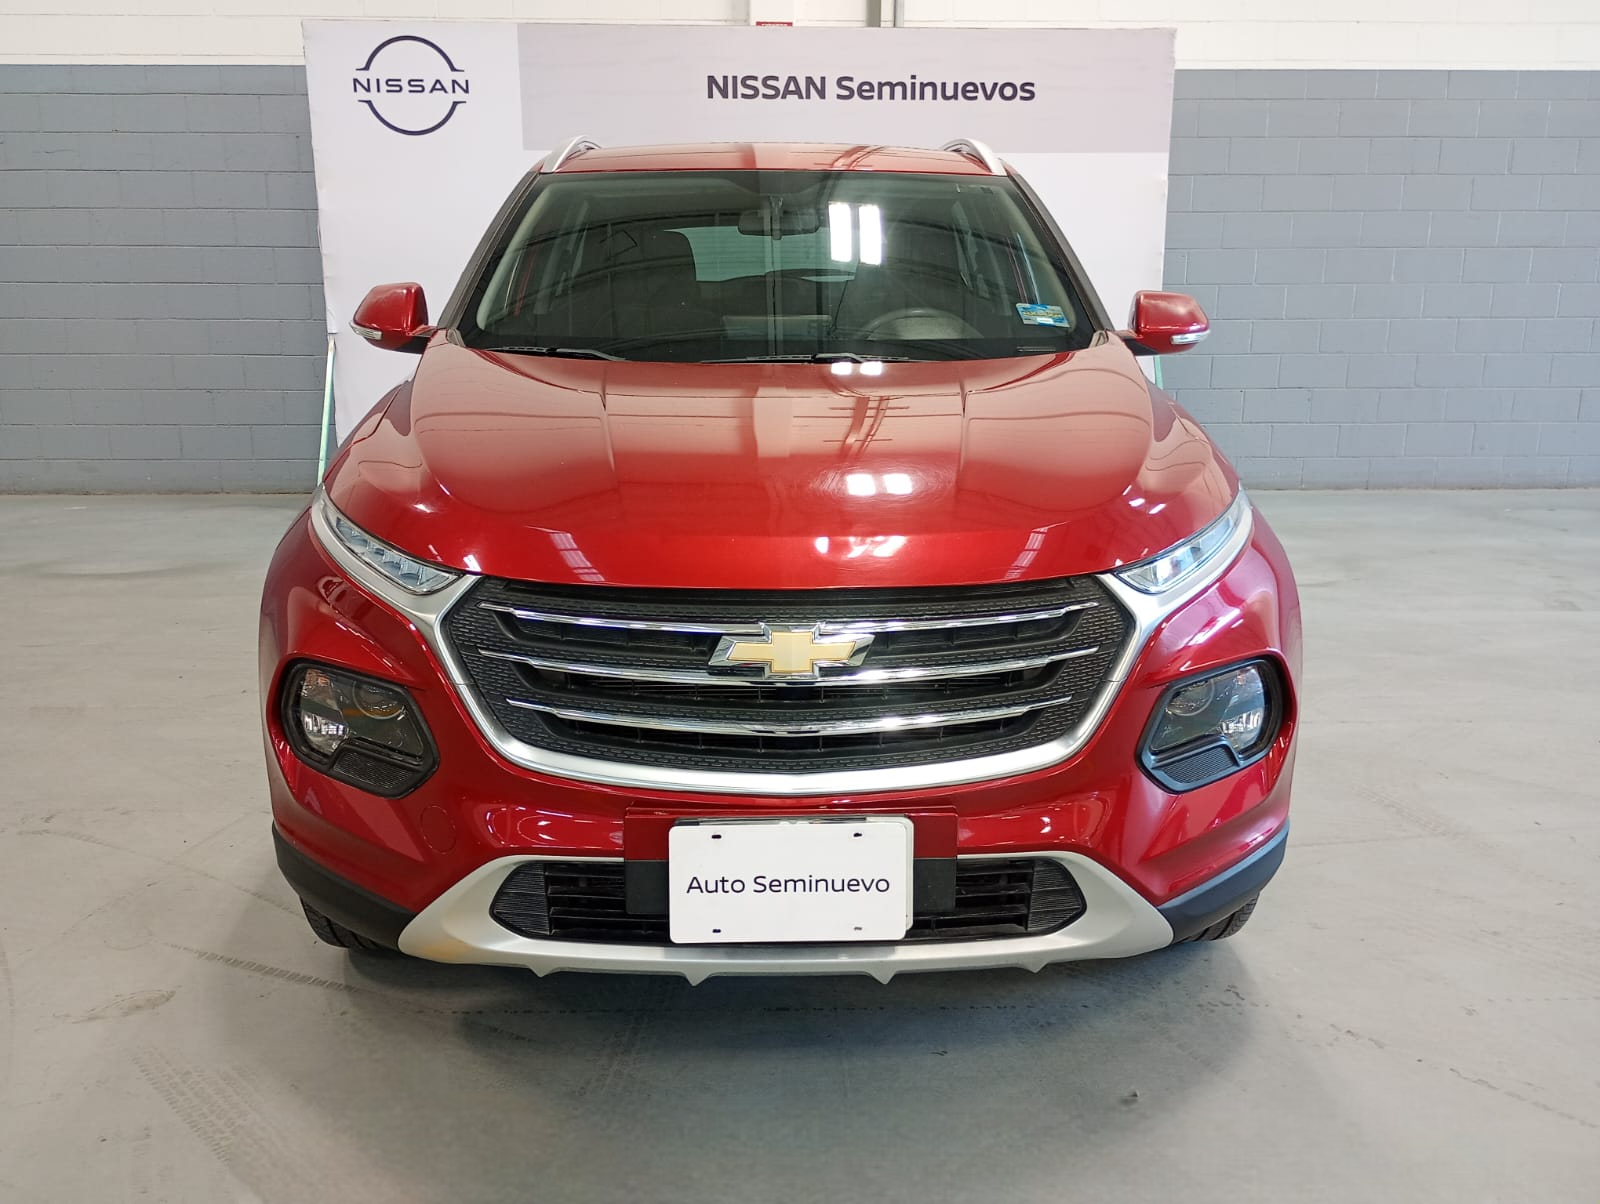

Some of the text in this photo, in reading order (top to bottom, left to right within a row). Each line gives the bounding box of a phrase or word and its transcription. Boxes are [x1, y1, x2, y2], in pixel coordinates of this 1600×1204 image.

[353, 78, 470, 94] NISSAN
[707, 75, 1036, 101] NISSAN Seminuevos
[686, 874, 890, 894] Auto Seminuevo
